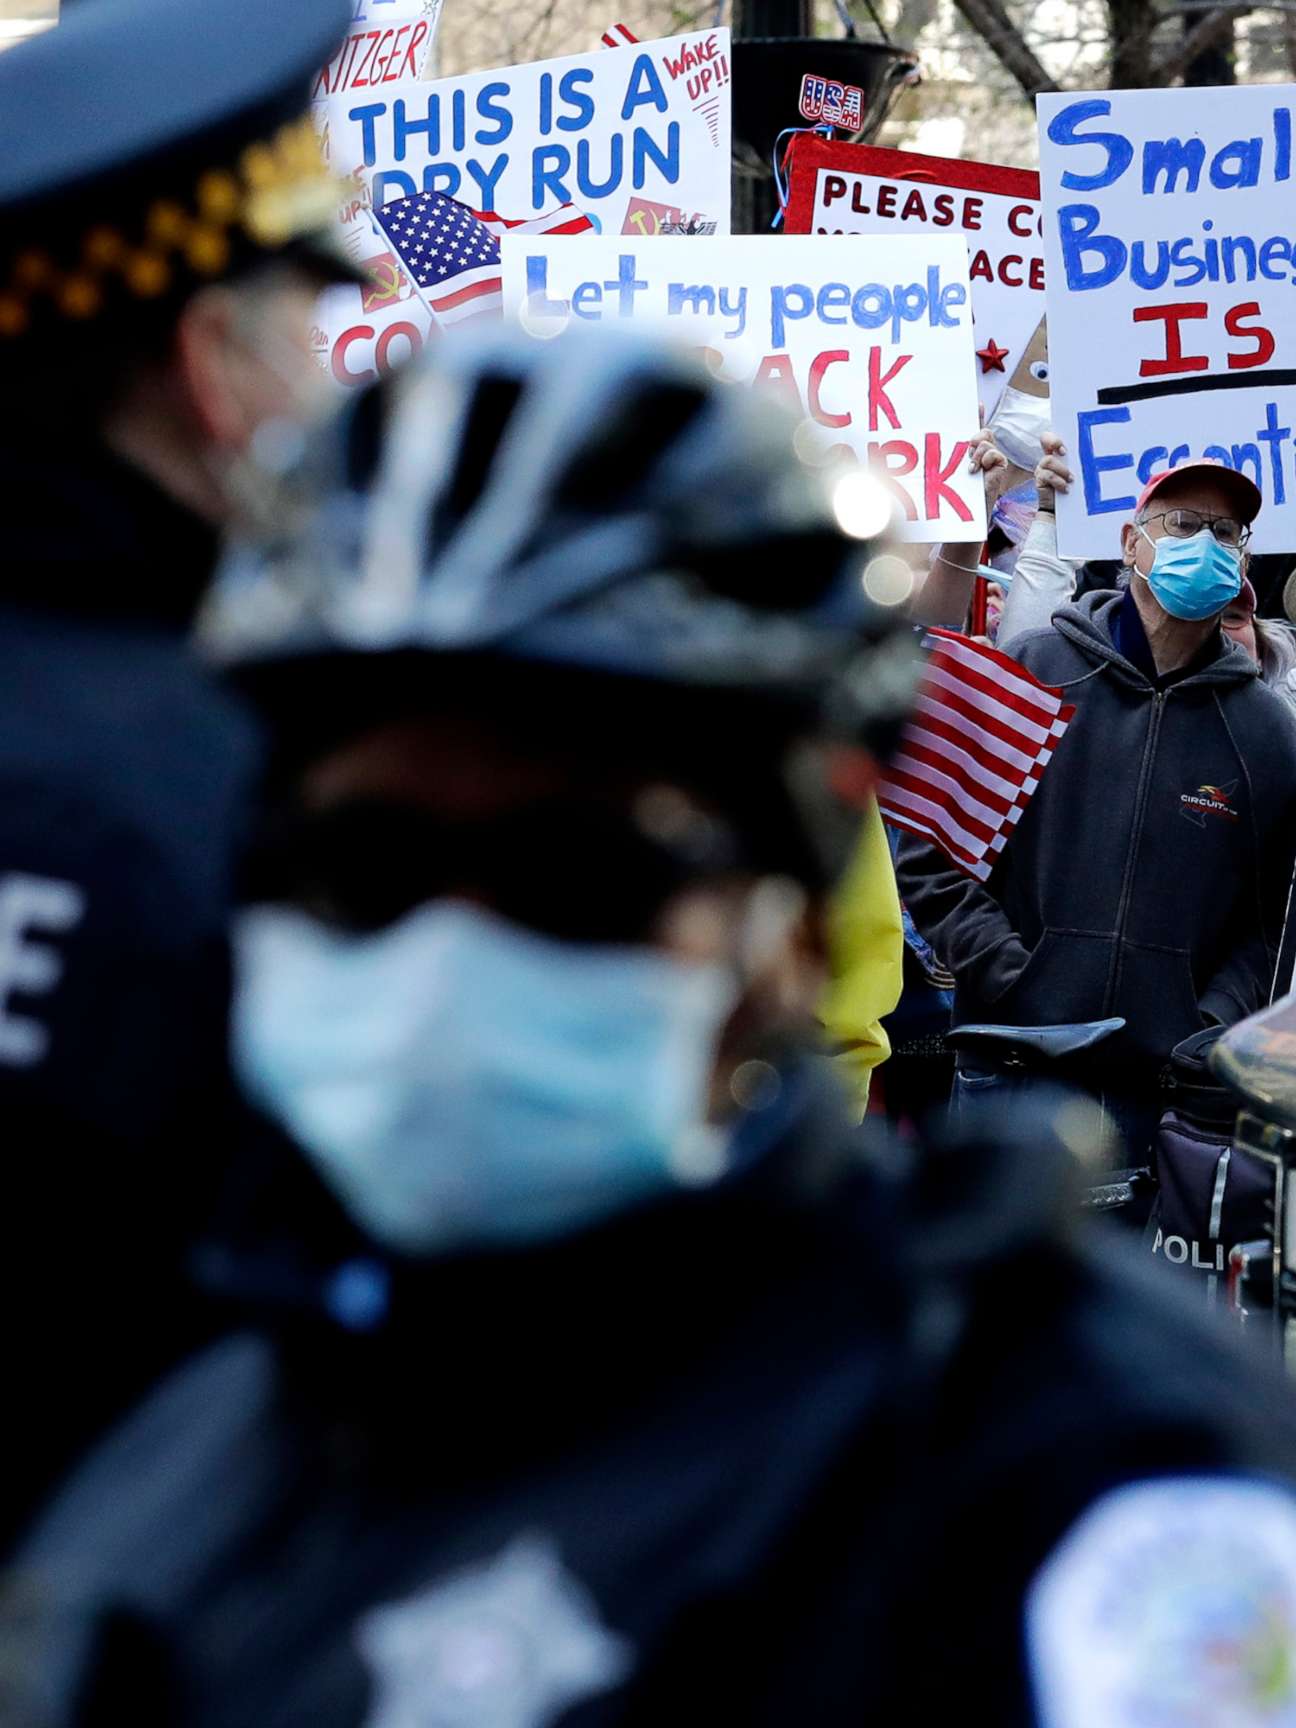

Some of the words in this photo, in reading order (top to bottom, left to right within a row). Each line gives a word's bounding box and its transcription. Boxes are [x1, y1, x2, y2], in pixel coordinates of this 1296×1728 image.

[662, 33, 721, 80] WAKE
[686, 55, 730, 100] UP!!
[348, 82, 514, 167] THIS
[539, 68, 595, 136] IS
[620, 53, 669, 121] A
[799, 74, 863, 131] USA
[531, 121, 680, 210] RUN
[823, 175, 984, 231] PLEASE
[1007, 204, 1042, 238] C
[968, 249, 1046, 291] ACE
[525, 254, 648, 318] Let
[666, 281, 748, 338] my
[769, 264, 967, 349] people
[1133, 301, 1276, 377] IS
[1180, 794, 1225, 810] CIRCUIT
